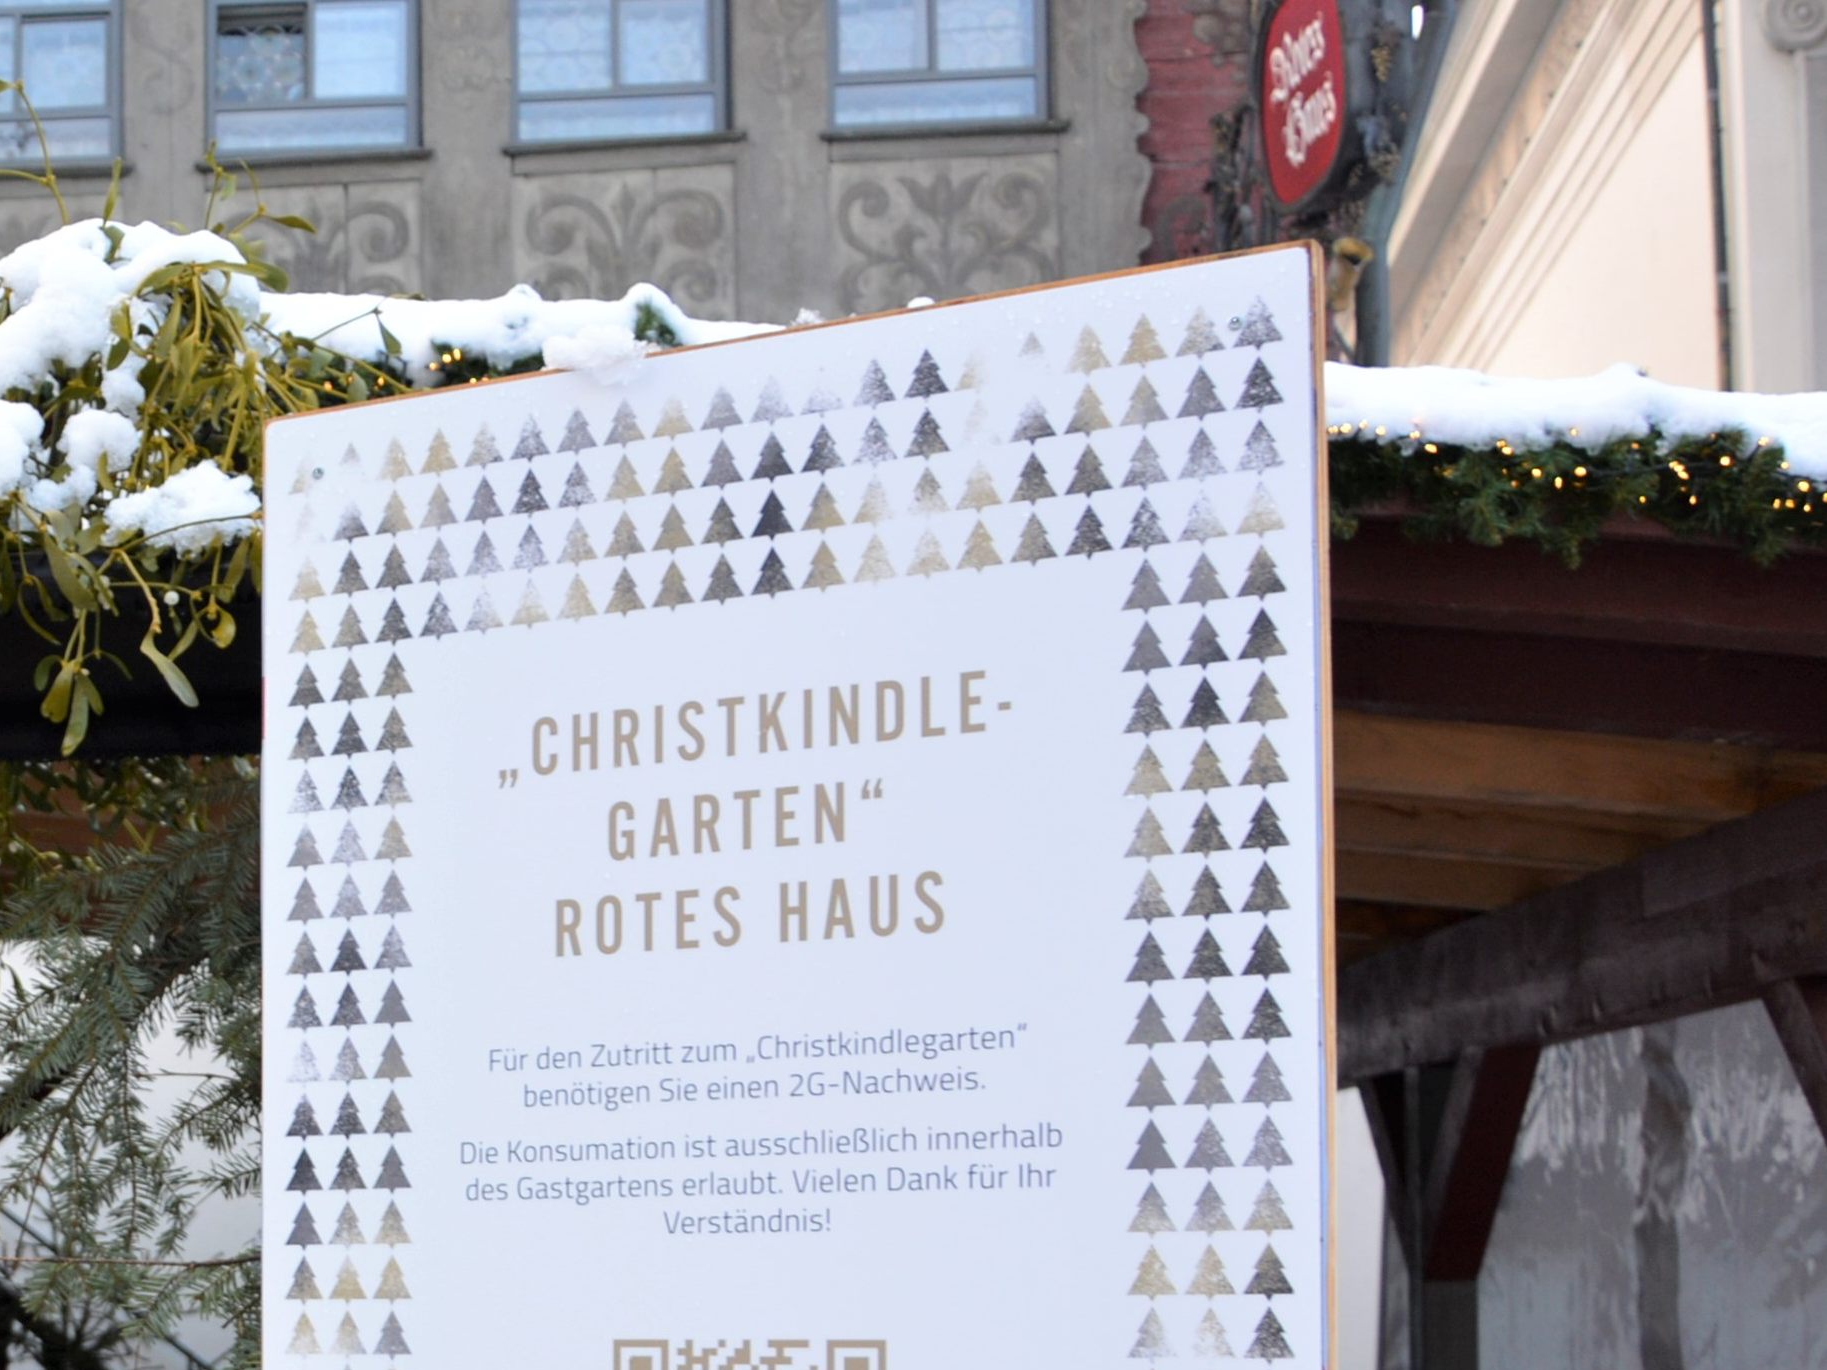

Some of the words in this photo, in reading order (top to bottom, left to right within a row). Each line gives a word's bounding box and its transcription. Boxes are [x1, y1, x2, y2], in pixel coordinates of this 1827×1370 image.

[555, 885, 742, 958] ROTES
[778, 870, 945, 943] HAUS
[488, 1046, 526, 1073] Für
[535, 1045, 582, 1071] den
[590, 1041, 674, 1068] Zutritt
[680, 1042, 737, 1064] zum
[523, 1081, 651, 1112] benötigen
[658, 1077, 699, 1103] Sie
[706, 1075, 780, 1101] einen
[788, 1065, 986, 1098] 2G-Nachweis.
[459, 1141, 499, 1166] Die
[507, 1135, 676, 1164] Konsumation
[684, 1134, 718, 1159] ist
[723, 1126, 918, 1158] ausschließlich
[927, 1121, 1063, 1151] innerhalb
[465, 1176, 509, 1202] des
[516, 1175, 674, 1207] Gastgartens
[681, 1169, 784, 1197] erlaubt.
[791, 1167, 877, 1195] Vielen
[886, 1164, 959, 1192] Dank
[966, 1162, 1010, 1190] für
[1018, 1162, 1057, 1189] Ihr
[662, 1207, 831, 1235] Verständnis!
